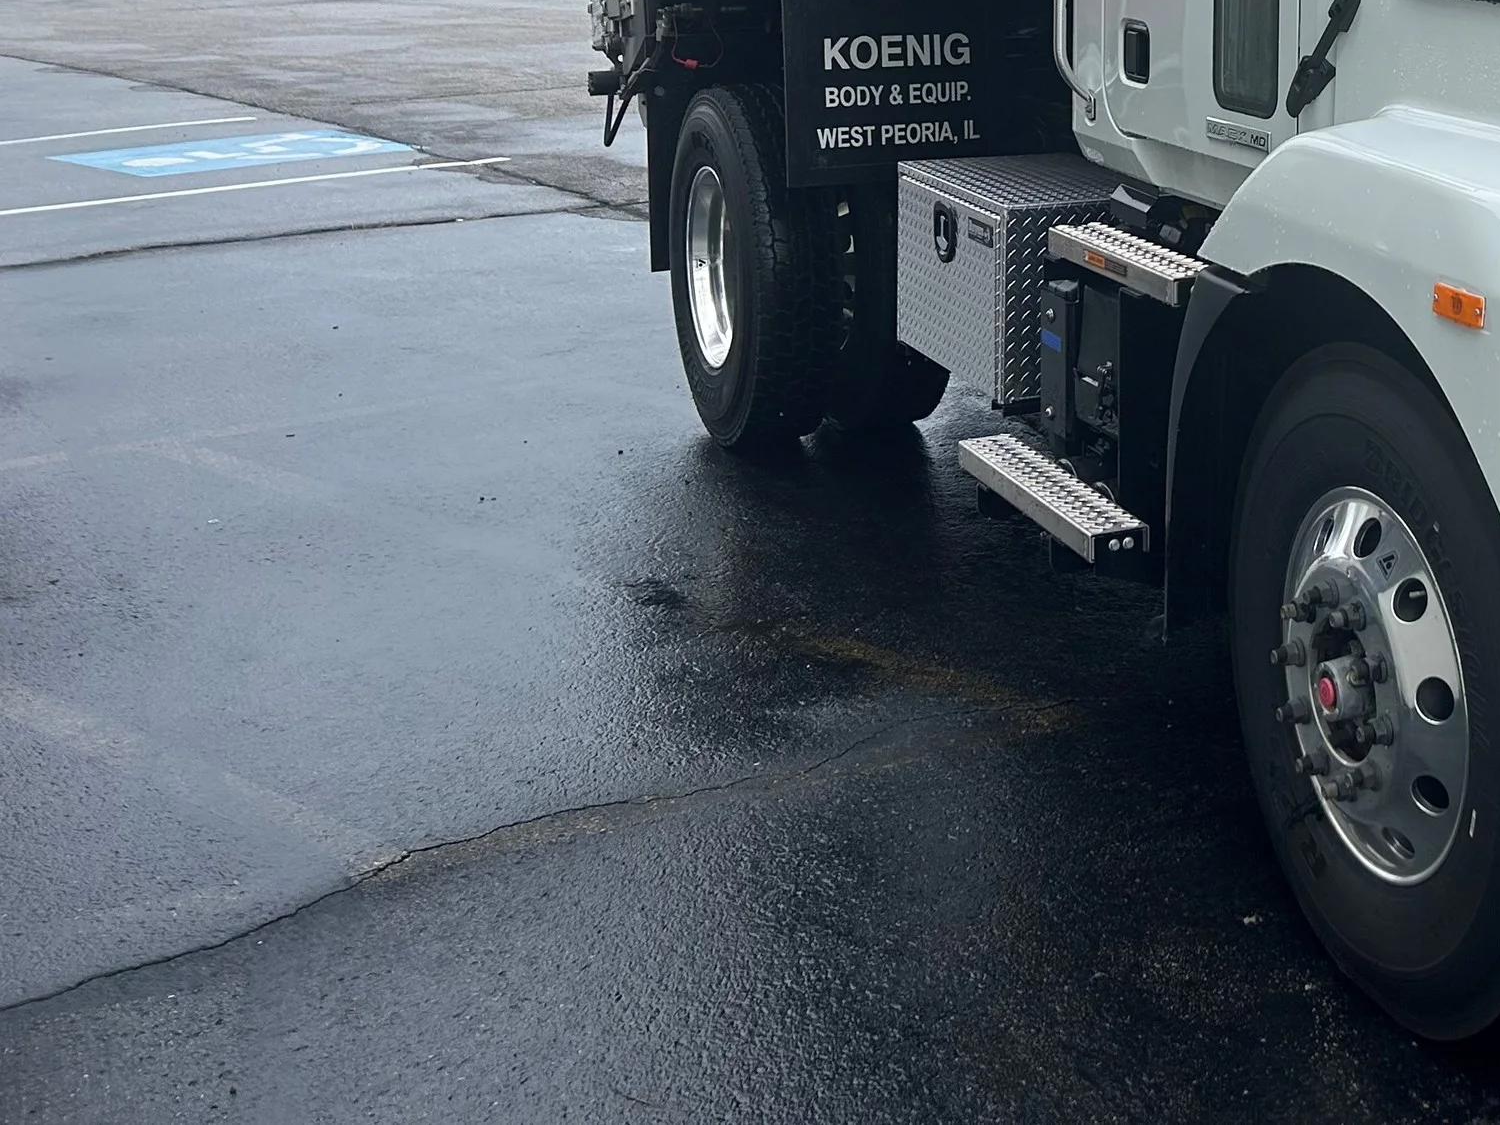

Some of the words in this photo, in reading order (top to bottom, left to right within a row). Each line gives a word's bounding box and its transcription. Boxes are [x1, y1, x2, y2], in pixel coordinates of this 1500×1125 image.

[823, 33, 971, 70] KOENIG
[825, 85, 884, 108] BODY
[889, 84, 903, 105] &
[909, 81, 972, 104] EQUIP.
[817, 126, 875, 149] WEST
[881, 121, 958, 144] PEORIA,
[964, 119, 981, 140] IL
[1250, 134, 1266, 146] MD
